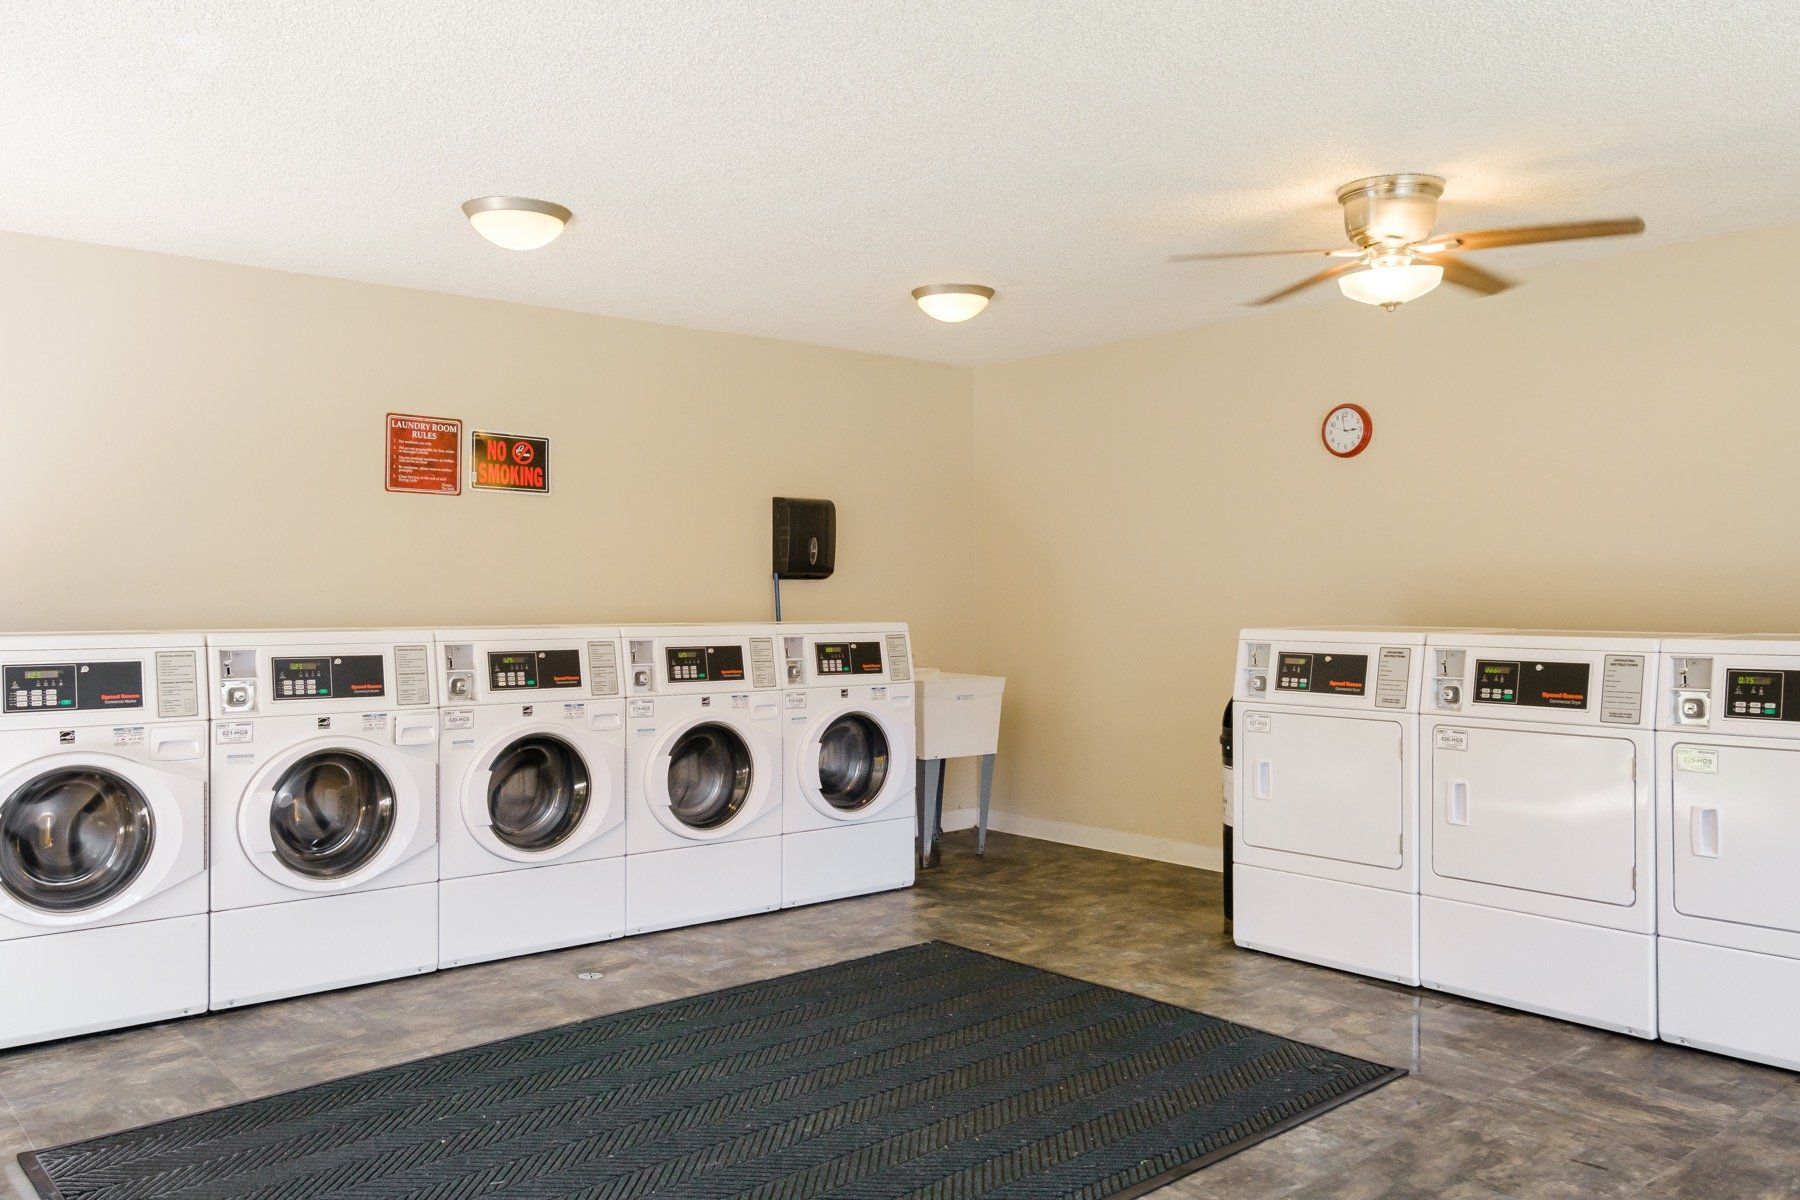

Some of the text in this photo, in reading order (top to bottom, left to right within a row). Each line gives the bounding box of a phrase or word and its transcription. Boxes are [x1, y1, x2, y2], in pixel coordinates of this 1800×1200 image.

[391, 420, 457, 433] LAUNDRY ROOM
[411, 430, 437, 440] RULES
[487, 440, 507, 462] NO
[478, 462, 543, 487] SMOKING
[1541, 691, 1584, 700] Speed Queen
